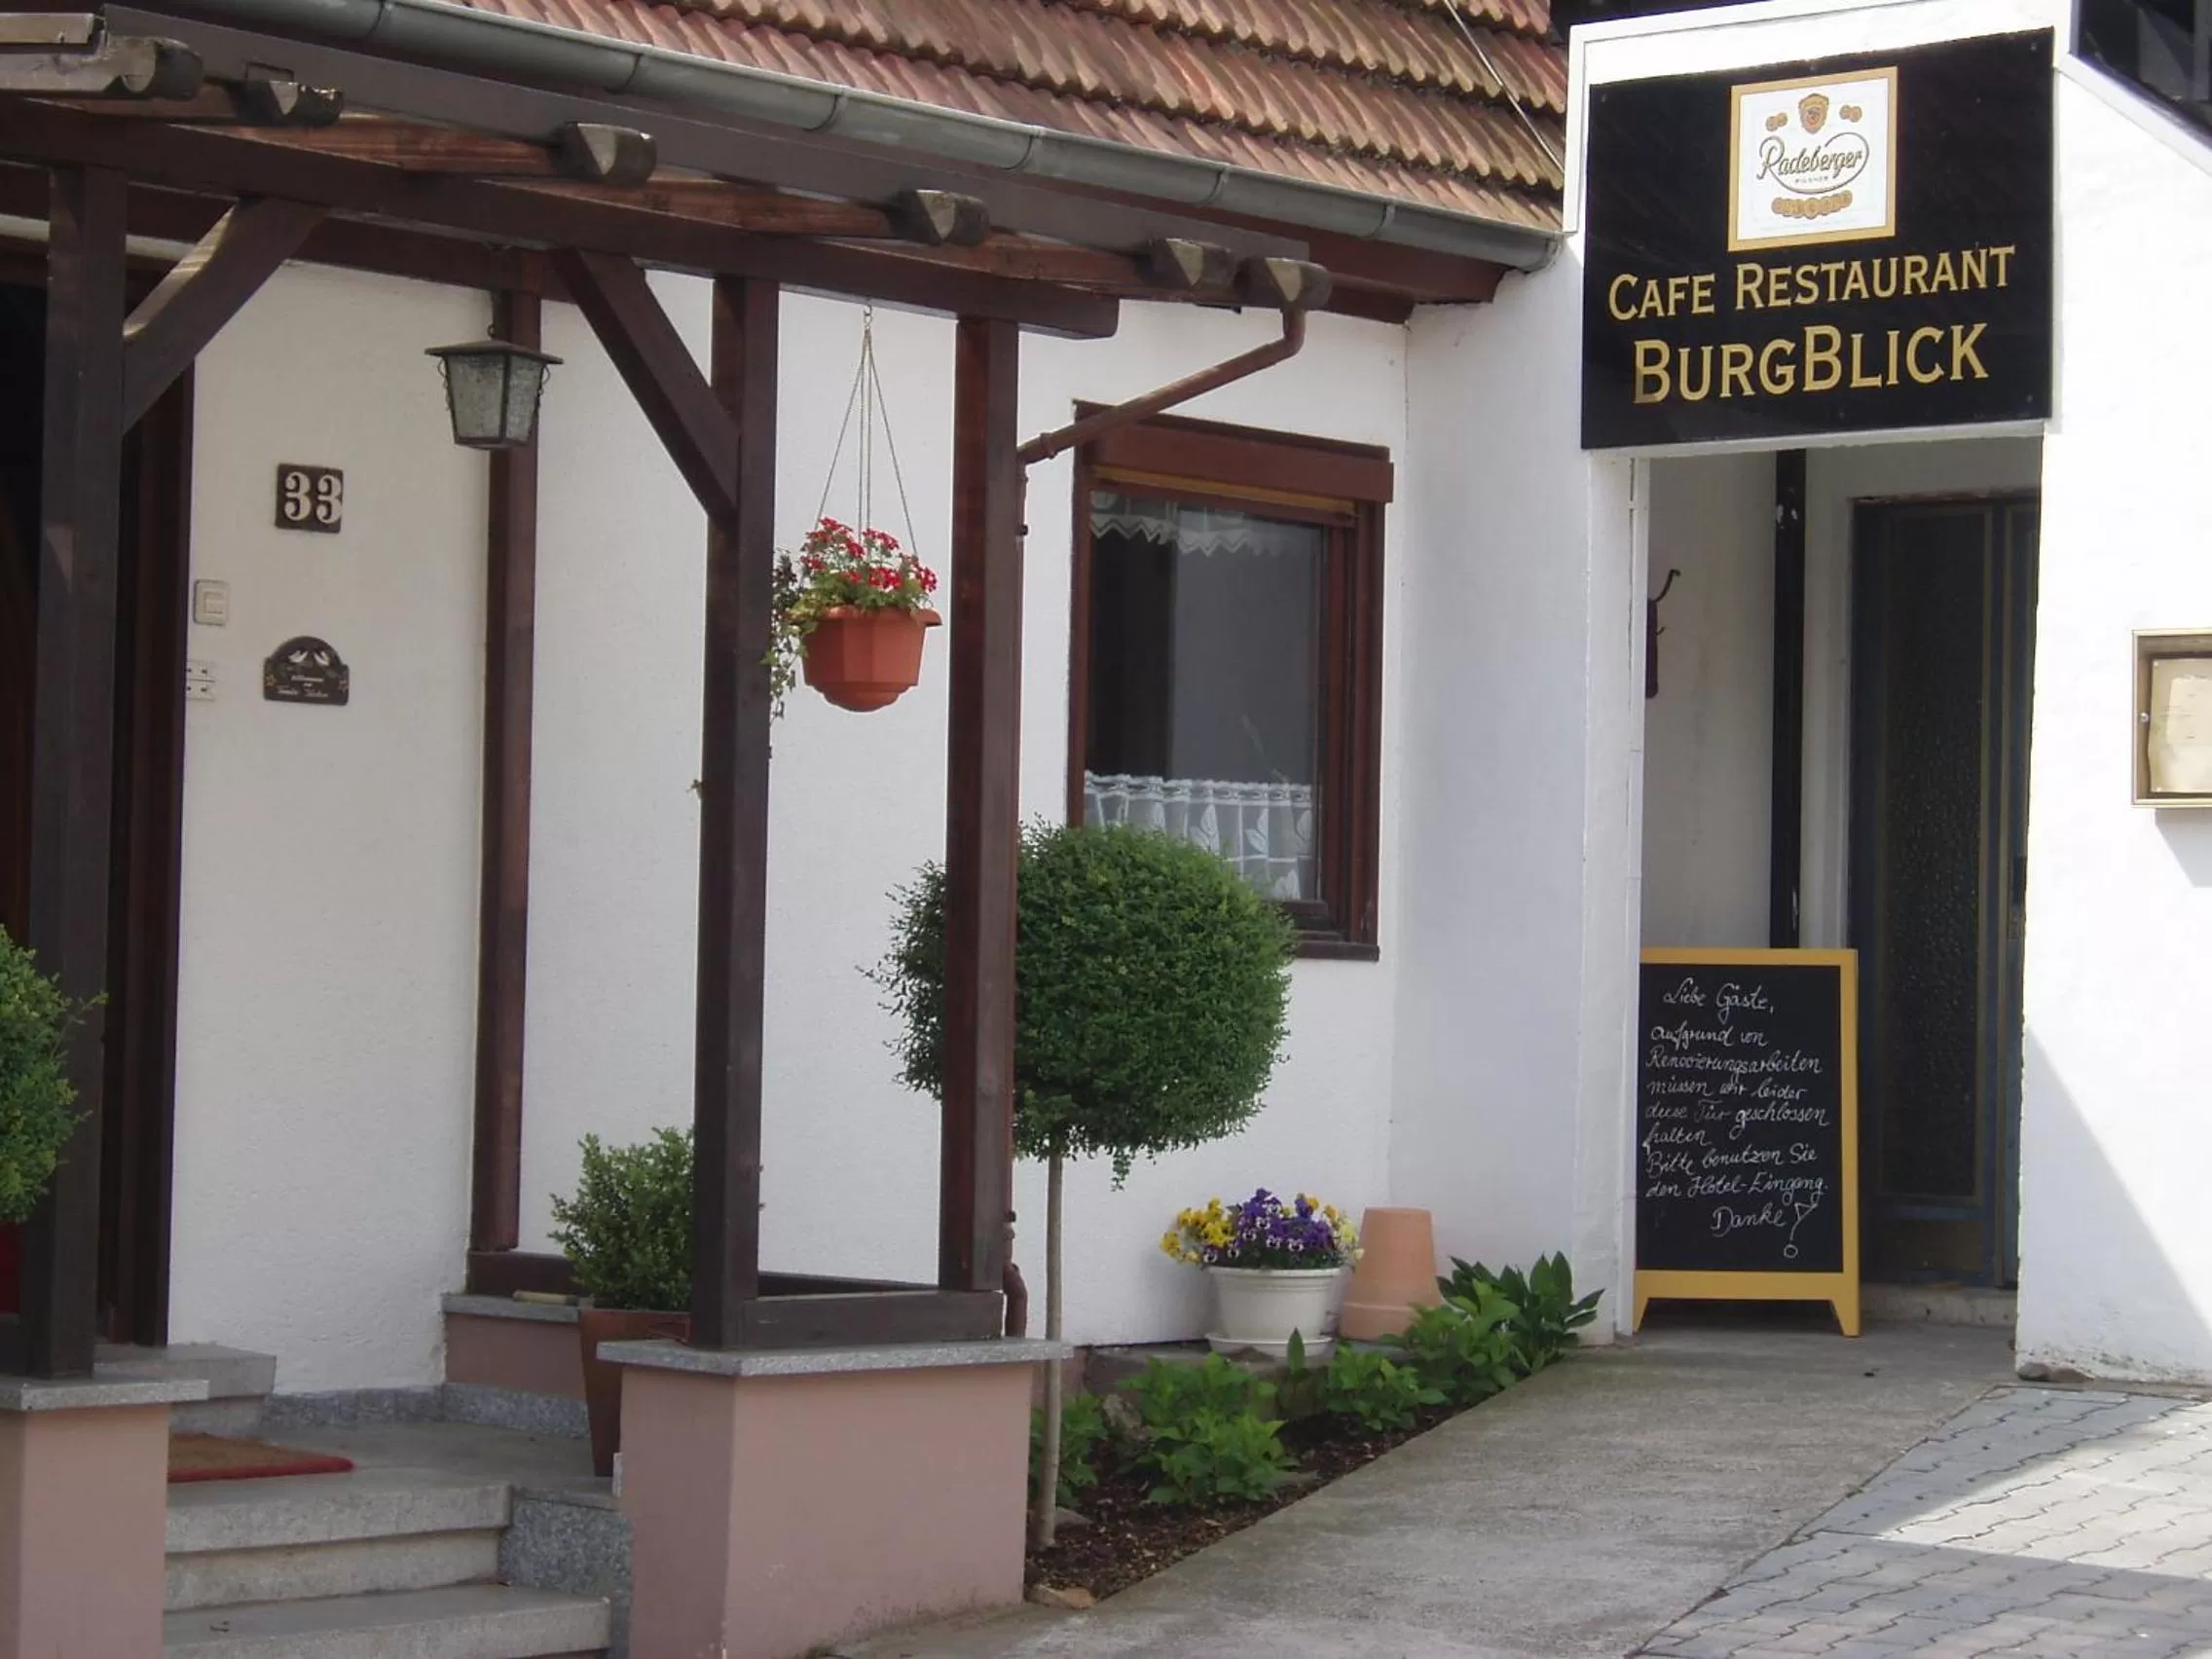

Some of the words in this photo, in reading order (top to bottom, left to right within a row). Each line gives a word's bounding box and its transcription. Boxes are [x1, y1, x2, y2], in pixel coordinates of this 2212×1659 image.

[1756, 132, 1869, 194] Radeberger
[1608, 274, 1715, 320] CAFE
[1735, 245, 2015, 311] RESTAURANT
[284, 471, 343, 524] 33
[1663, 977, 1706, 1007] Liebe
[1741, 1030, 1768, 1047] von
[1646, 1075, 1714, 1096] müssen
[1751, 1077, 1808, 1100] leider
[1694, 1098, 1731, 1123] Tür
[1729, 1100, 1829, 1140] geschlossen
[1645, 1150, 1696, 1179] Bitte
[1703, 1144, 1784, 1168] benutzen
[1789, 1142, 1818, 1164] Sie
[1645, 1181, 1681, 1198] den
